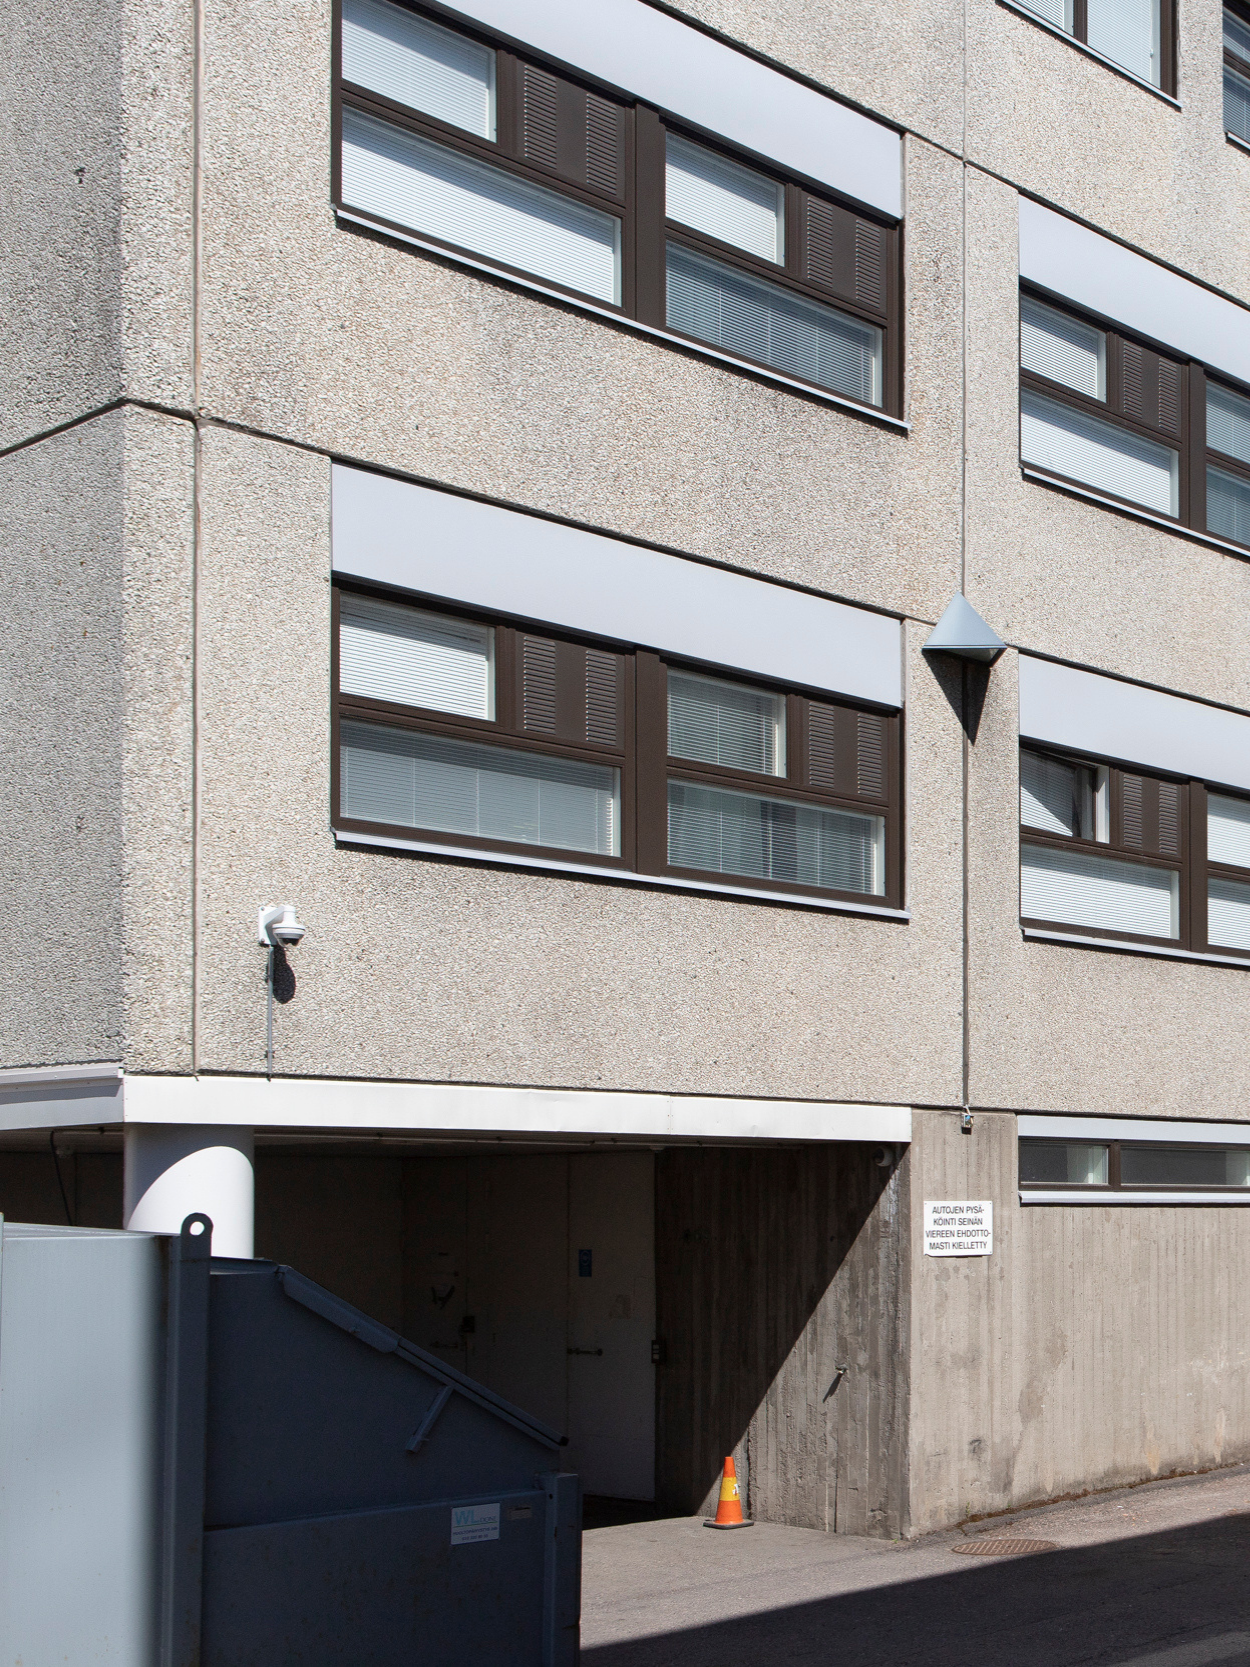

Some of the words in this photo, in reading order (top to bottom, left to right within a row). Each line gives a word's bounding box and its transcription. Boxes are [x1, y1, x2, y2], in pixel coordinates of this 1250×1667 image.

[932, 1206, 964, 1214] AUTOJEN
[966, 1204, 984, 1213] PYSÄ-
[933, 1217, 956, 1226] KÖINTI
[958, 1216, 983, 1226] SEINÄN
[925, 1230, 955, 1238] VIEREEN
[956, 1229, 991, 1238] EHDOTTO-
[929, 1242, 951, 1250] MASTI
[952, 1241, 988, 1250] KIELLETTY
